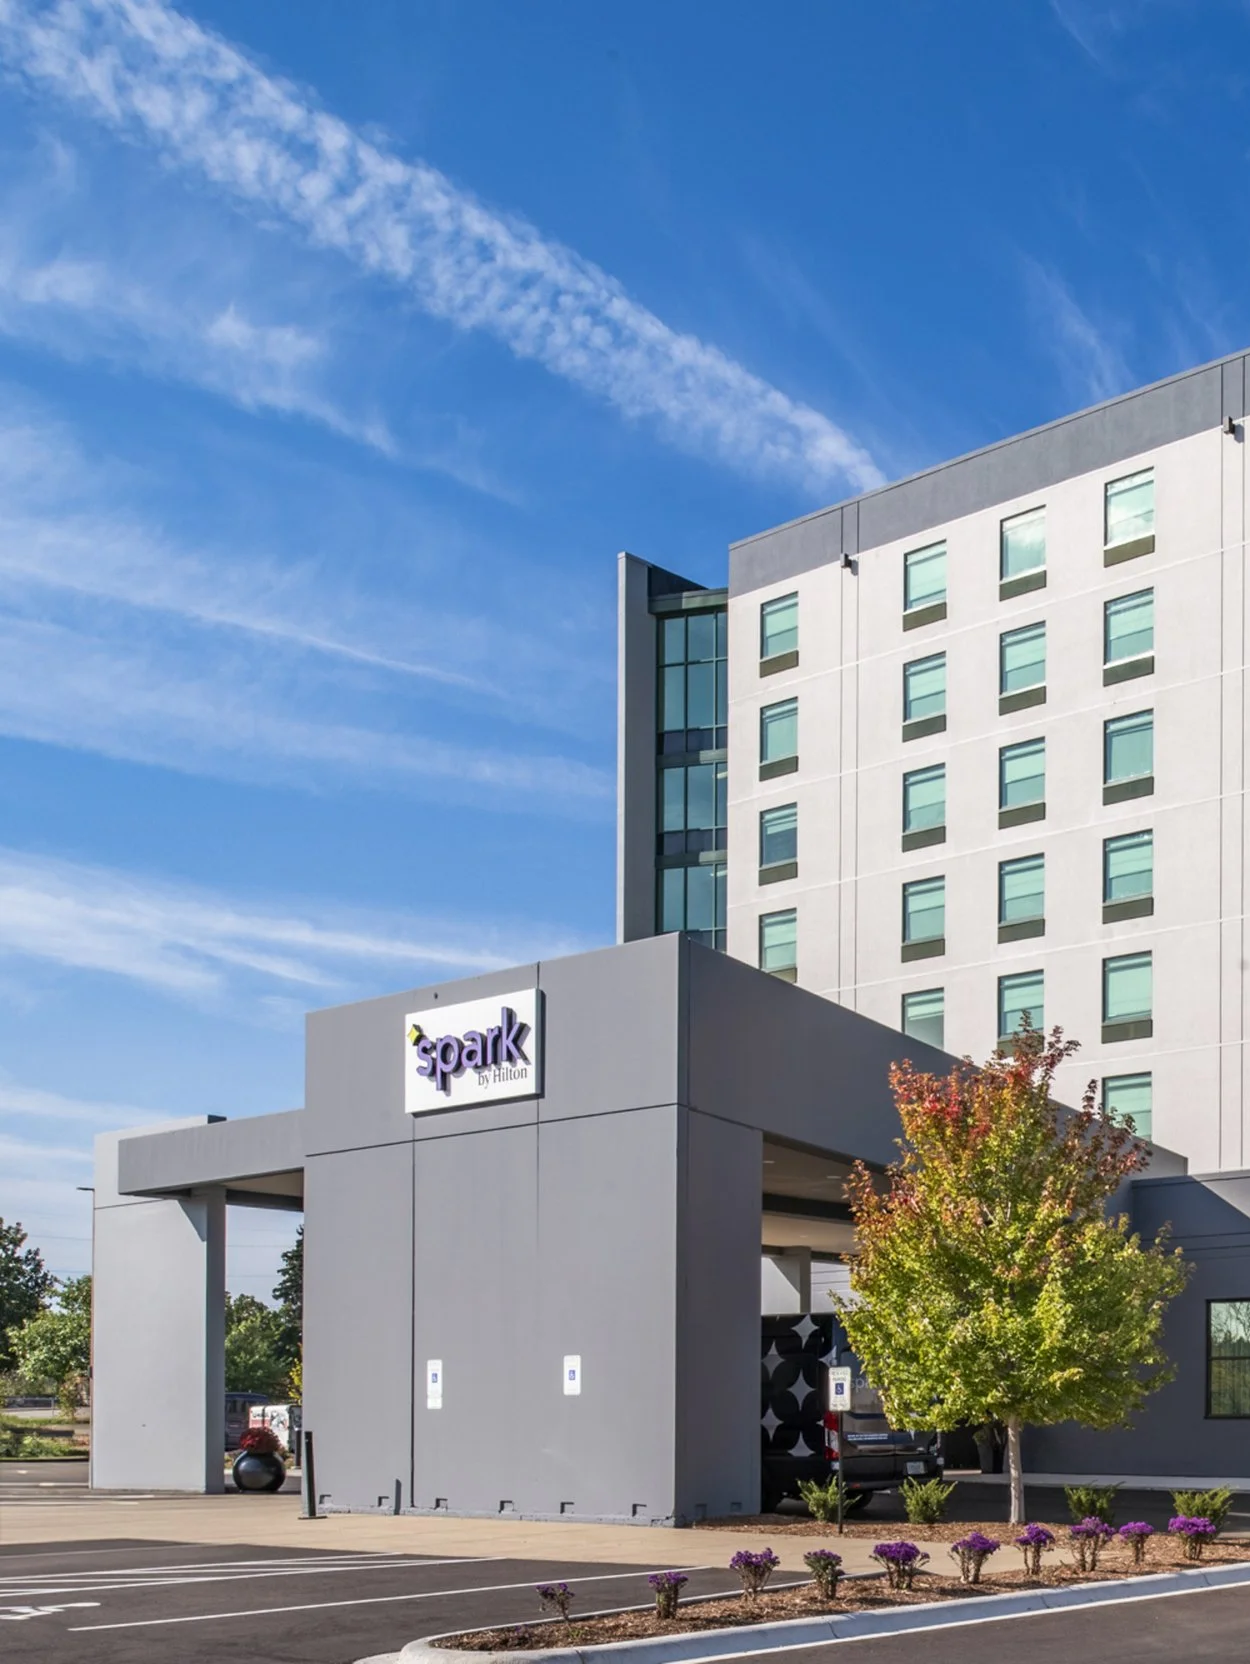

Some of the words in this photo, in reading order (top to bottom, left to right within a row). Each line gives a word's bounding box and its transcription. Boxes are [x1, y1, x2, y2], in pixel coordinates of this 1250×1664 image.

[415, 1006, 530, 1092] spark
[478, 1071, 490, 1089] by
[493, 1067, 528, 1083] Hilton
